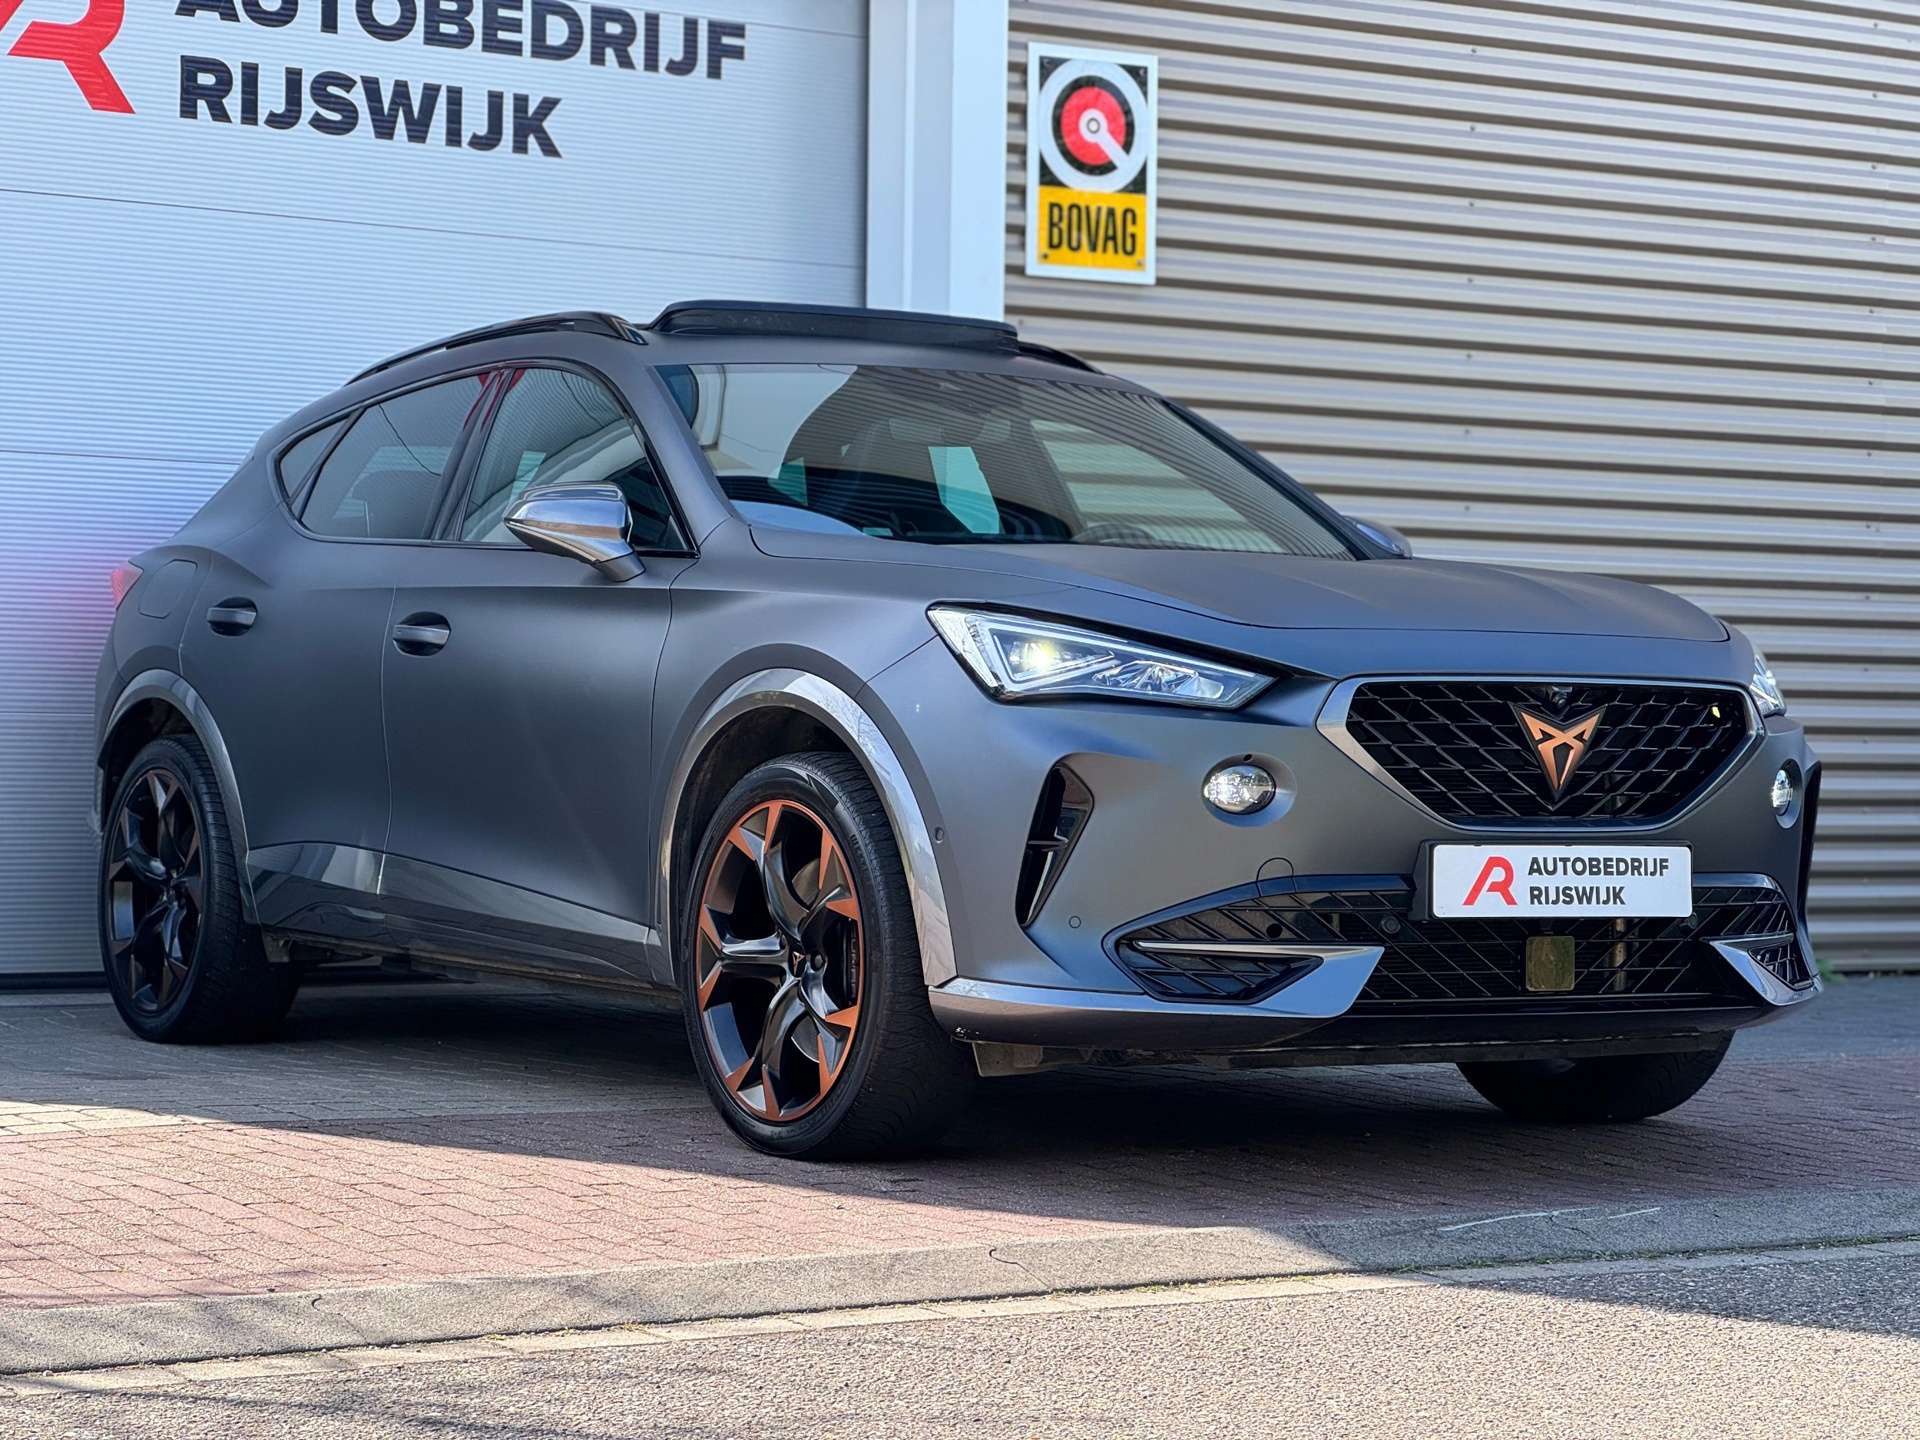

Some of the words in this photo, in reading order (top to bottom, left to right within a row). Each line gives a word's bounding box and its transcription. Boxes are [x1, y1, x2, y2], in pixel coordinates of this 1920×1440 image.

[179, 54, 563, 158] RIJSWIJK
[1048, 202, 1137, 256] BOVAG
[1527, 856, 1669, 876] AUTOBEDRIJF
[1529, 885, 1626, 905] RIJSWIJK
